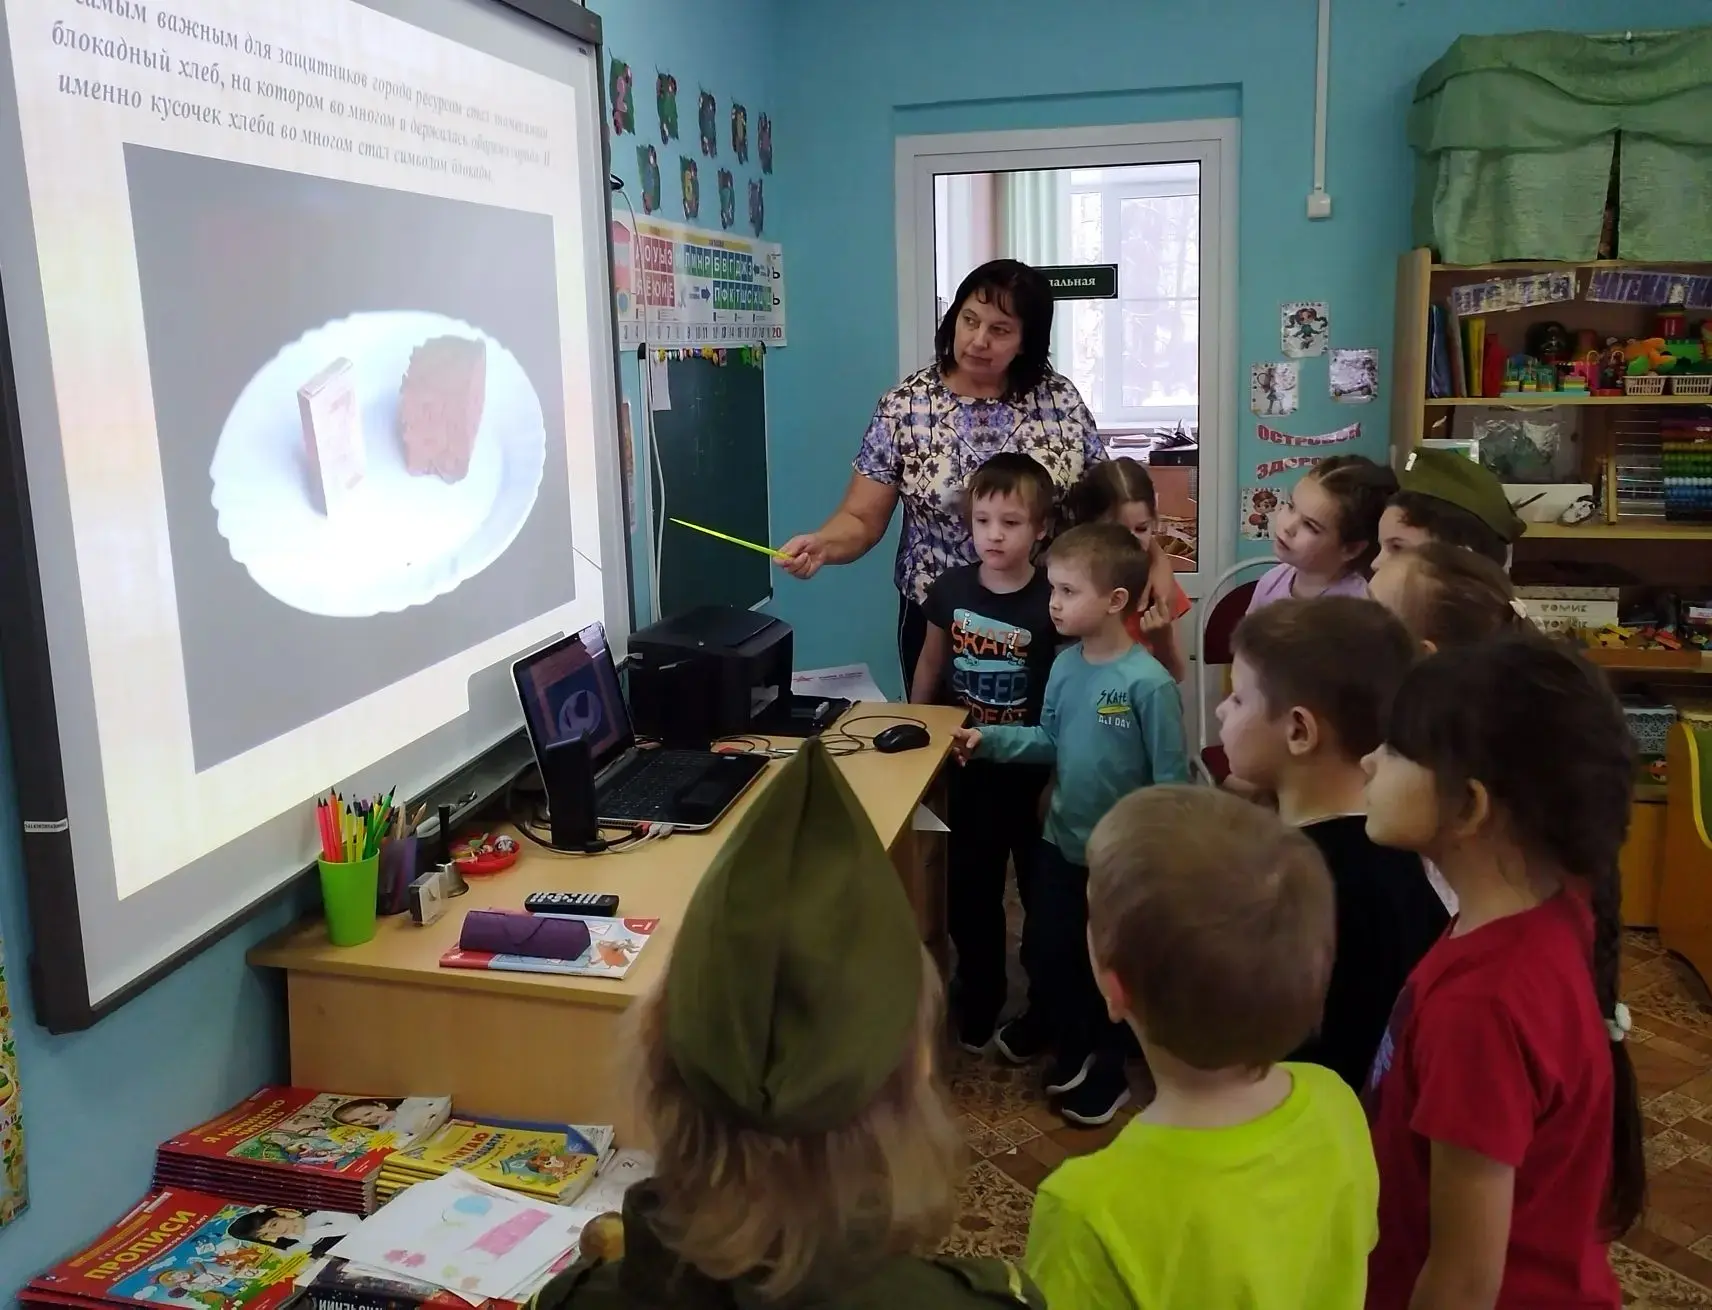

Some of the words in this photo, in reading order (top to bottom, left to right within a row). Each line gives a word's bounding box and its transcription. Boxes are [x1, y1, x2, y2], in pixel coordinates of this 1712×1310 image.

[76, 0, 147, 24] мым
[157, 11, 239, 51] важным
[245, 31, 272, 60] для
[277, 47, 368, 89] защитников
[372, 75, 412, 101] города
[52, 20, 171, 73] блокадный
[178, 59, 225, 93] хлеб,
[231, 73, 251, 93] на
[257, 80, 324, 112] котором
[330, 100, 345, 116] во
[348, 104, 395, 130] многом
[58, 72, 142, 109] именно
[150, 93, 222, 129] кусочек
[228, 112, 275, 138] хлеба
[280, 123, 297, 141] во
[301, 129, 353, 153] многом
[358, 141, 389, 160] стал
[394, 150, 448, 174] символом
[772, 326, 782, 339] 20
[951, 621, 1028, 657] SKATE
[1543, 620, 1587, 629] ТОК
[1114, 717, 1131, 729] DAY
[202, 1136, 222, 1144] Я
[84, 1210, 198, 1281] ПРОПИСИ
